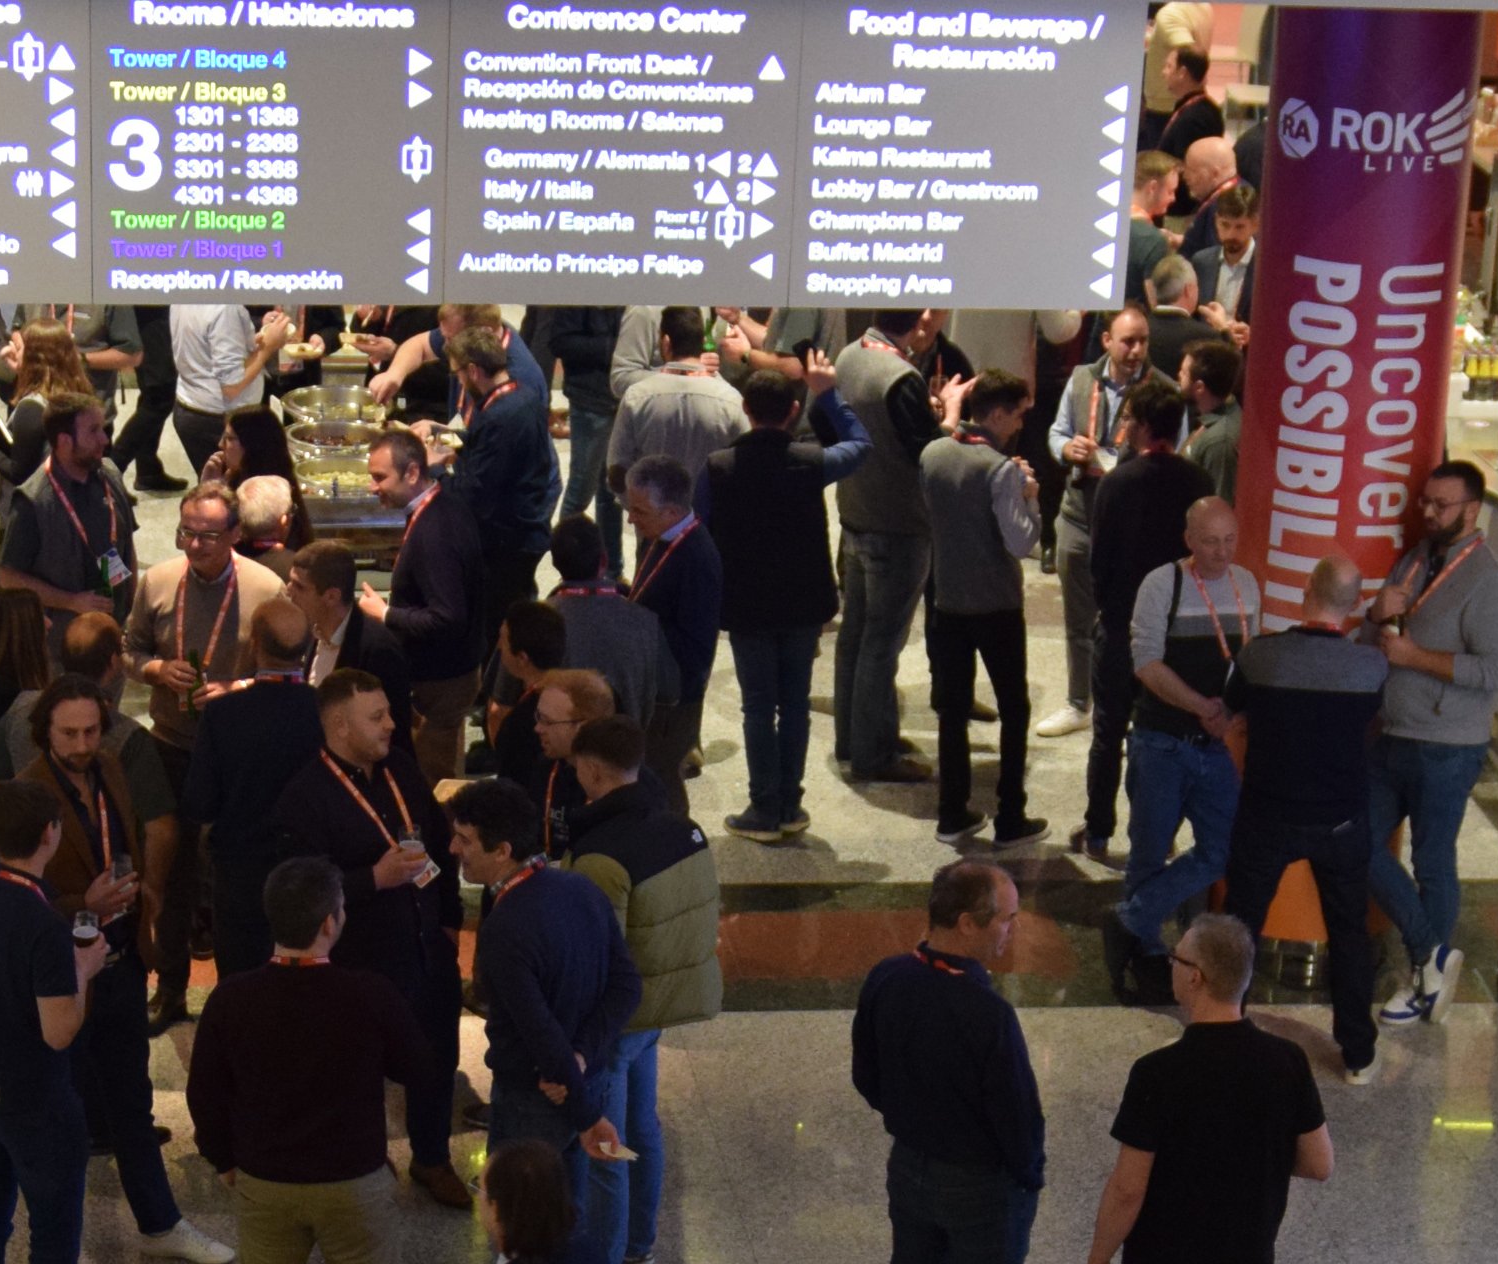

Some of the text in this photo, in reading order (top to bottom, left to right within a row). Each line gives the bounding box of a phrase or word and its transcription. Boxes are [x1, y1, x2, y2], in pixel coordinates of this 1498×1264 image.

[133, 1, 415, 28] Rooms / Habitaciones
[507, 4, 746, 33] Conference Center
[849, 9, 1105, 44] Food and Beverage /
[109, 48, 287, 72] Tower / Bloque 4
[464, 51, 714, 76] Convention Front Desk /
[893, 43, 1055, 71] Restauración
[109, 81, 287, 106] Tower / Bloque 3
[464, 78, 754, 104] Recepción de Convenciones
[815, 83, 926, 105] Atrium Bar
[174, 106, 299, 127] 1301 - 1368
[463, 109, 724, 133] Meeting Rooms / Salones
[814, 114, 932, 139] Lounge Bar
[1282, 116, 1311, 143] RA
[1331, 107, 1426, 153] ROK
[174, 132, 299, 153] 2301 - 2368
[108, 118, 163, 192] 3
[485, 148, 752, 175] Germany / Alemania 1 2
[881, 147, 992, 169] Restaurant
[1364, 155, 1435, 173] LIVE
[173, 159, 298, 180] 3301 - 3368
[173, 186, 298, 206] 4301 - 4368
[484, 179, 751, 203] Italy / Italia 1 2
[811, 178, 875, 202] Lobby
[878, 179, 915, 199] Bar
[916, 179, 928, 199] /
[110, 210, 285, 233] Tower / Bloque 2
[483, 210, 635, 234] Spain / España
[655, 210, 709, 224] Floor E /
[809, 210, 964, 234] Champions Bar
[696, 226, 707, 240] E
[110, 240, 284, 262] Tower / Bloque 1
[808, 242, 943, 263] Buffet Madrid
[459, 253, 704, 278] Auditorio Príncipe Felipe
[110, 270, 344, 294] Reception / Recepción
[806, 273, 952, 297] Shopping Area
[1357, 262, 1444, 549] Uncover
